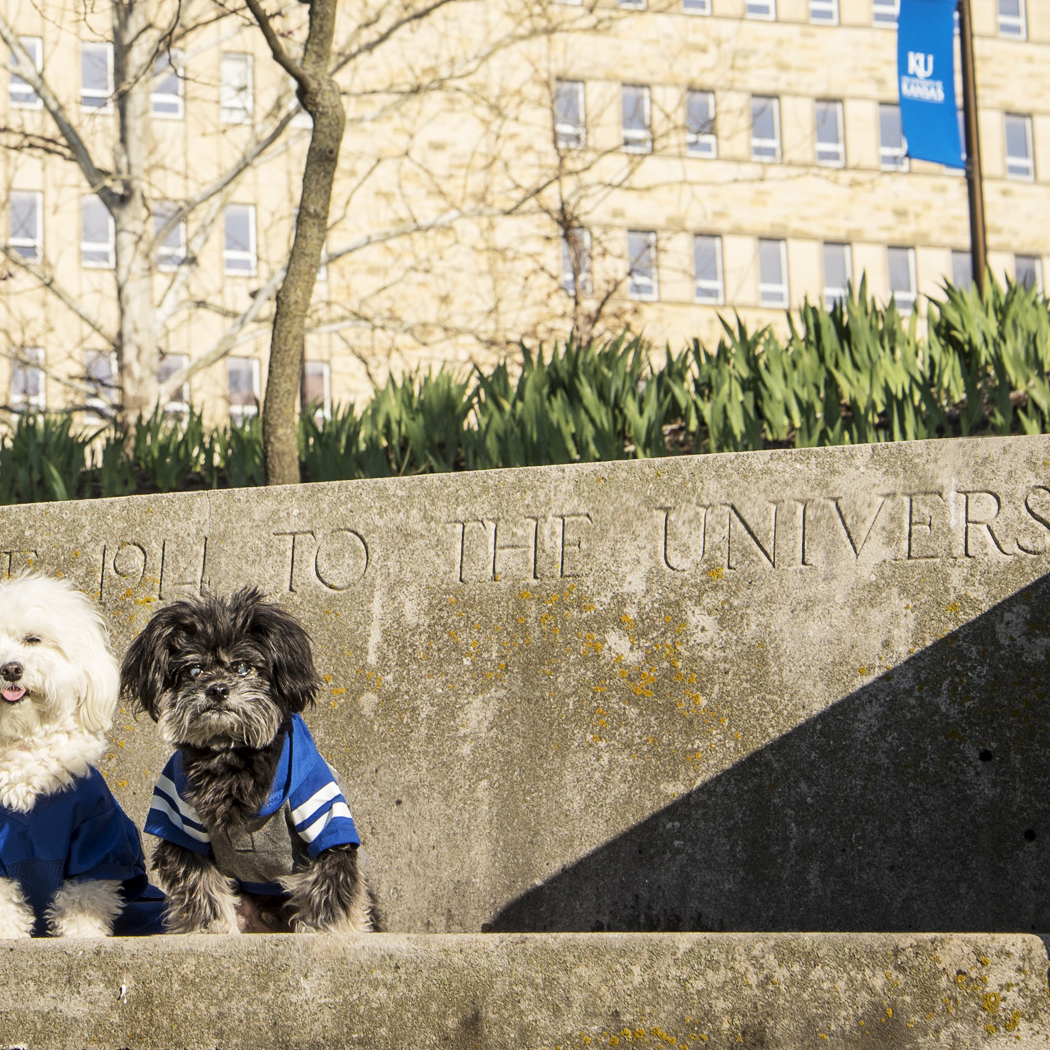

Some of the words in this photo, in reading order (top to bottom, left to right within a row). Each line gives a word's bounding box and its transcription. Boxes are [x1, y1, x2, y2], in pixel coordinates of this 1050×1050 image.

[907, 51, 934, 79] KU
[98, 533, 211, 602] 1914
[272, 527, 369, 593] TO
[444, 511, 594, 584] THE
[652, 484, 1050, 573] UNIVERS
